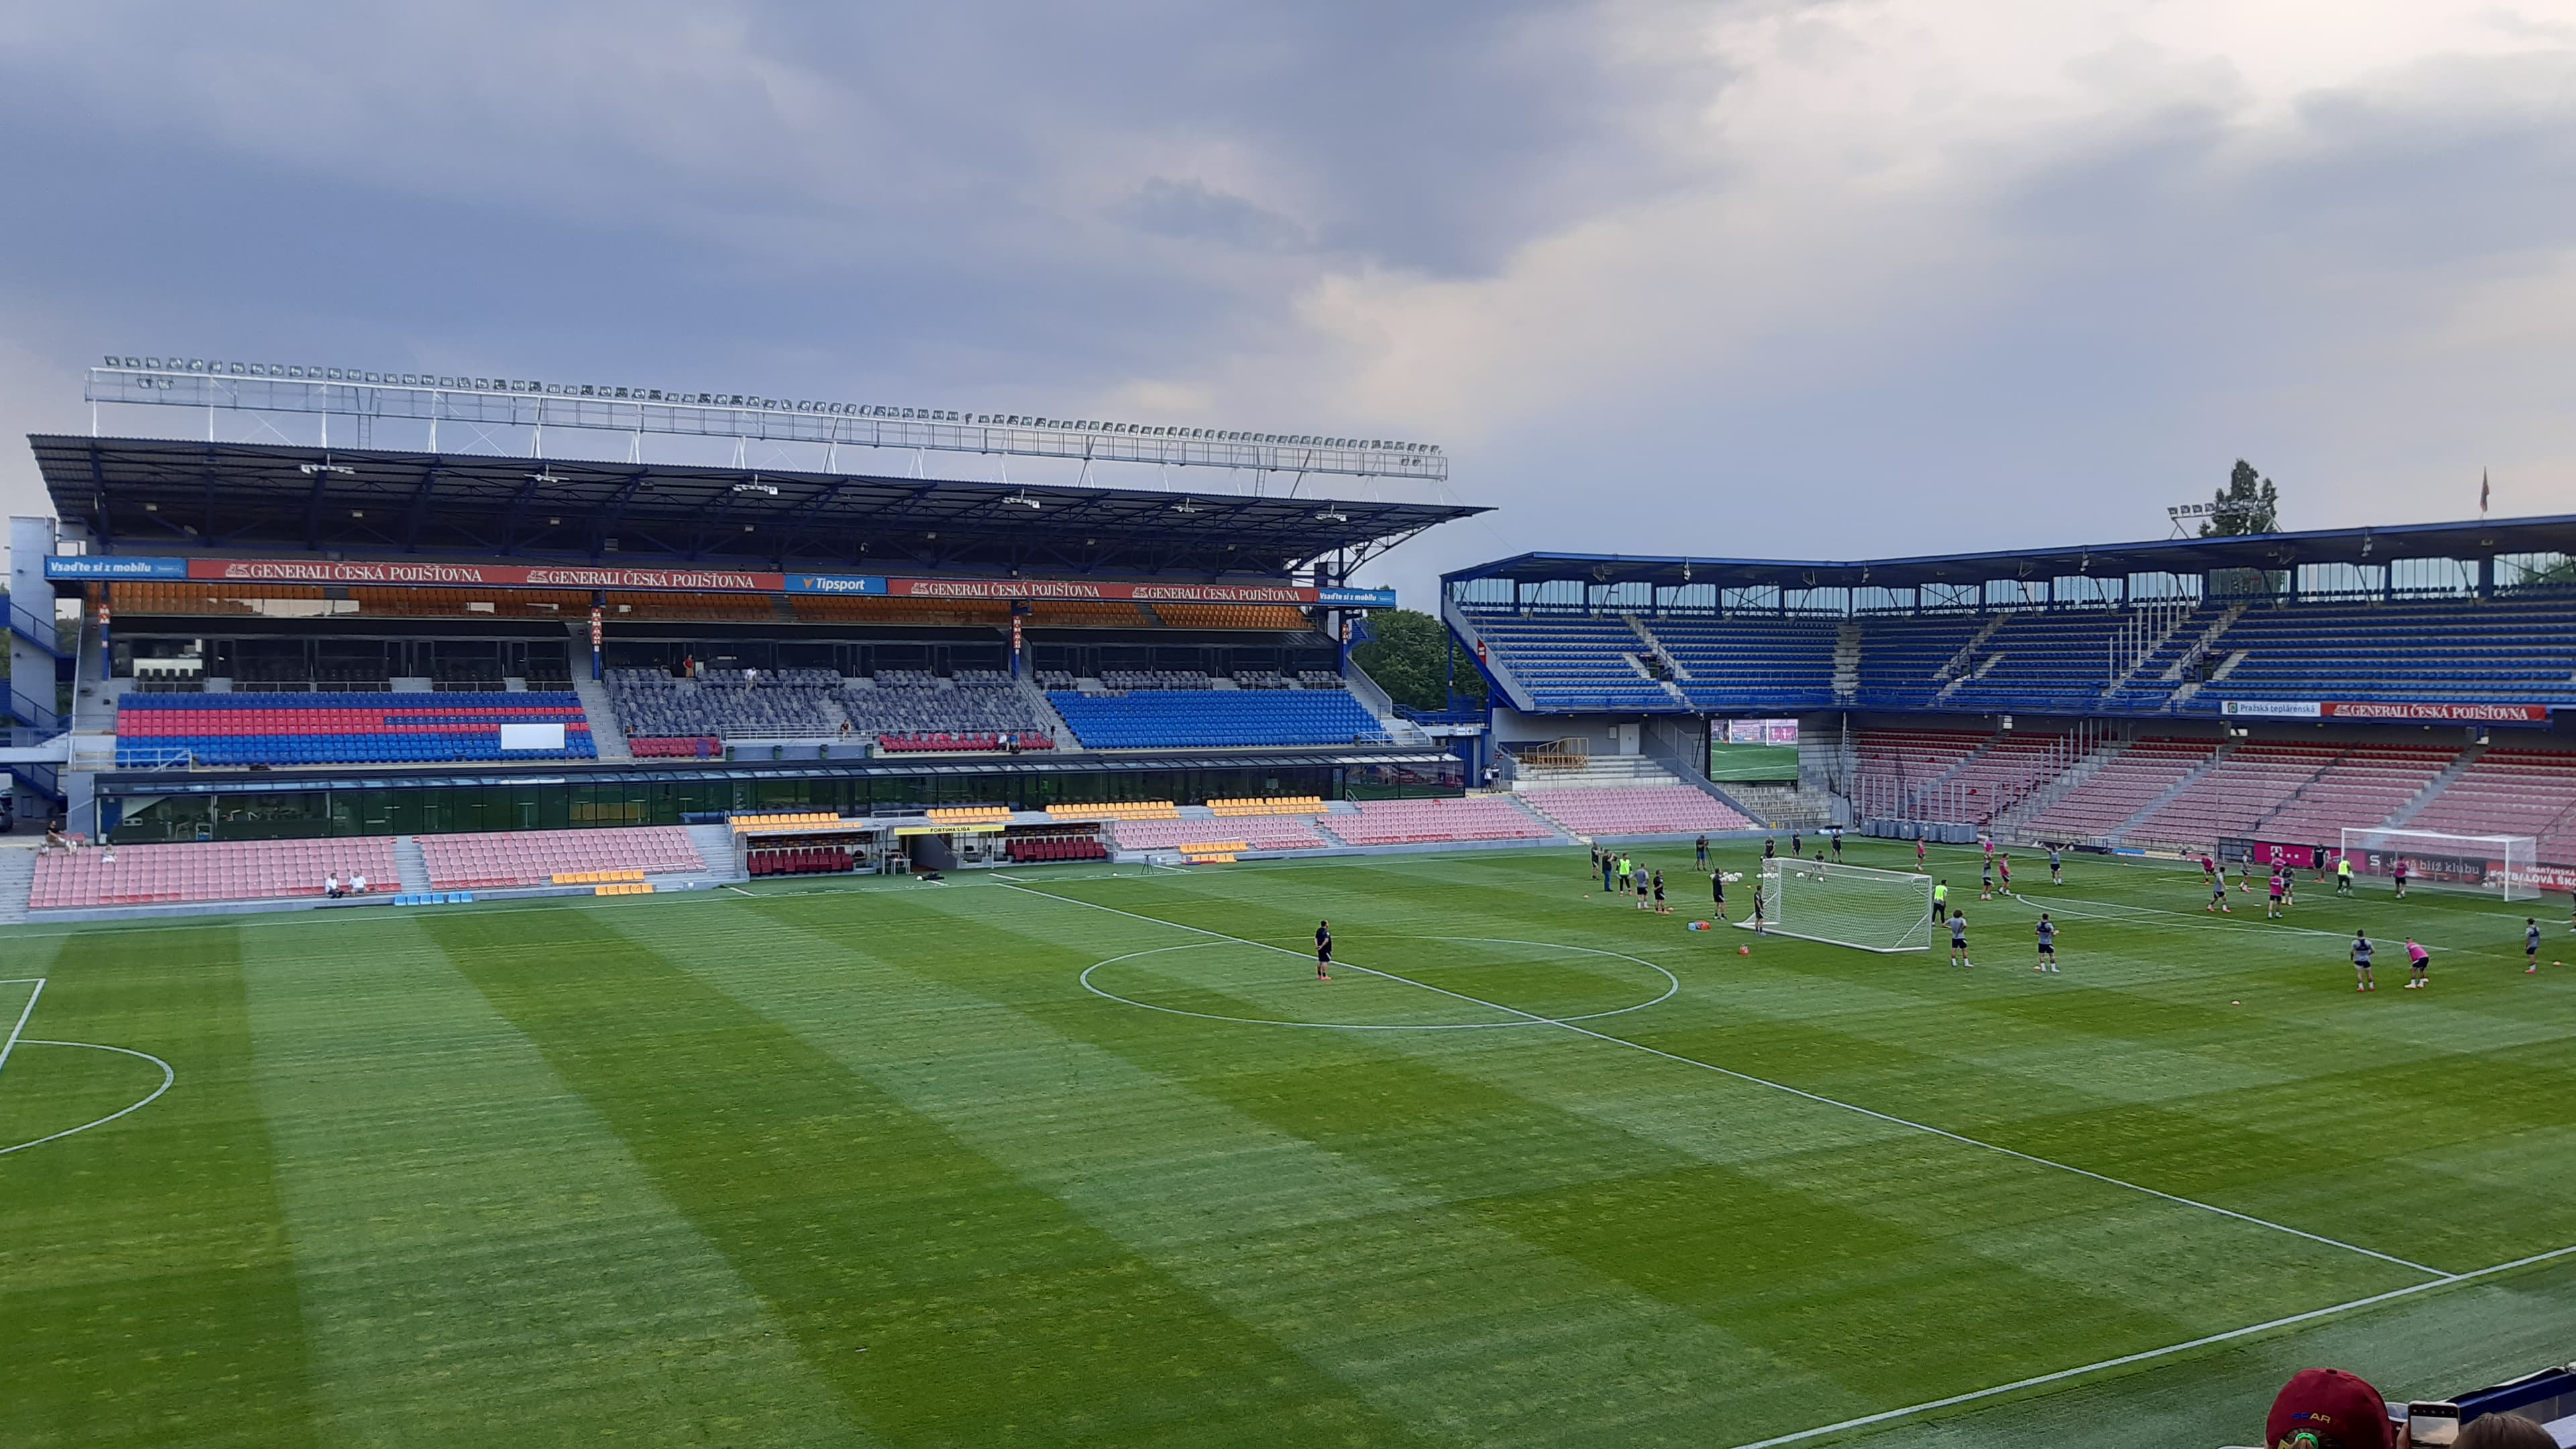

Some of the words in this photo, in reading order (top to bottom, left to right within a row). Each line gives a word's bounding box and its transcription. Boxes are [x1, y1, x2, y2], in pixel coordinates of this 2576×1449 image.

[51, 561, 91, 572] Vsaďte
[93, 561, 103, 572] si
[105, 564, 110, 572] z
[113, 562, 152, 573] mobilu
[250, 564, 331, 580] GENERALI
[335, 563, 386, 580] ČESKÁ
[390, 565, 483, 582] POJIŠŤOVNA
[549, 570, 620, 584] GENERALI
[624, 570, 667, 586] ČESKÁ
[672, 572, 755, 588] POJIŠŤOVNA
[816, 578, 865, 592] Tipsport
[929, 583, 988, 596] GENERALI
[991, 582, 1028, 596] ČESKÁ
[1032, 582, 1100, 598] POJIŠŤOVNA
[1148, 587, 1200, 600] GENERALI
[1203, 586, 1236, 600] ČESKÁ
[1240, 588, 1299, 601] POJIŠŤOVNA
[1320, 592, 1342, 600] Vsaďte
[1343, 593, 1350, 601] si
[1354, 593, 1377, 602] mobilu
[2240, 704, 2269, 712] Pražská
[2270, 704, 2315, 714] teplárenská
[2350, 704, 2409, 717] GENERALI
[2410, 704, 2449, 718] ČESKÁ
[2453, 704, 2529, 720] POJIŠŤOVNA
[2445, 862, 2479, 875] klubu
